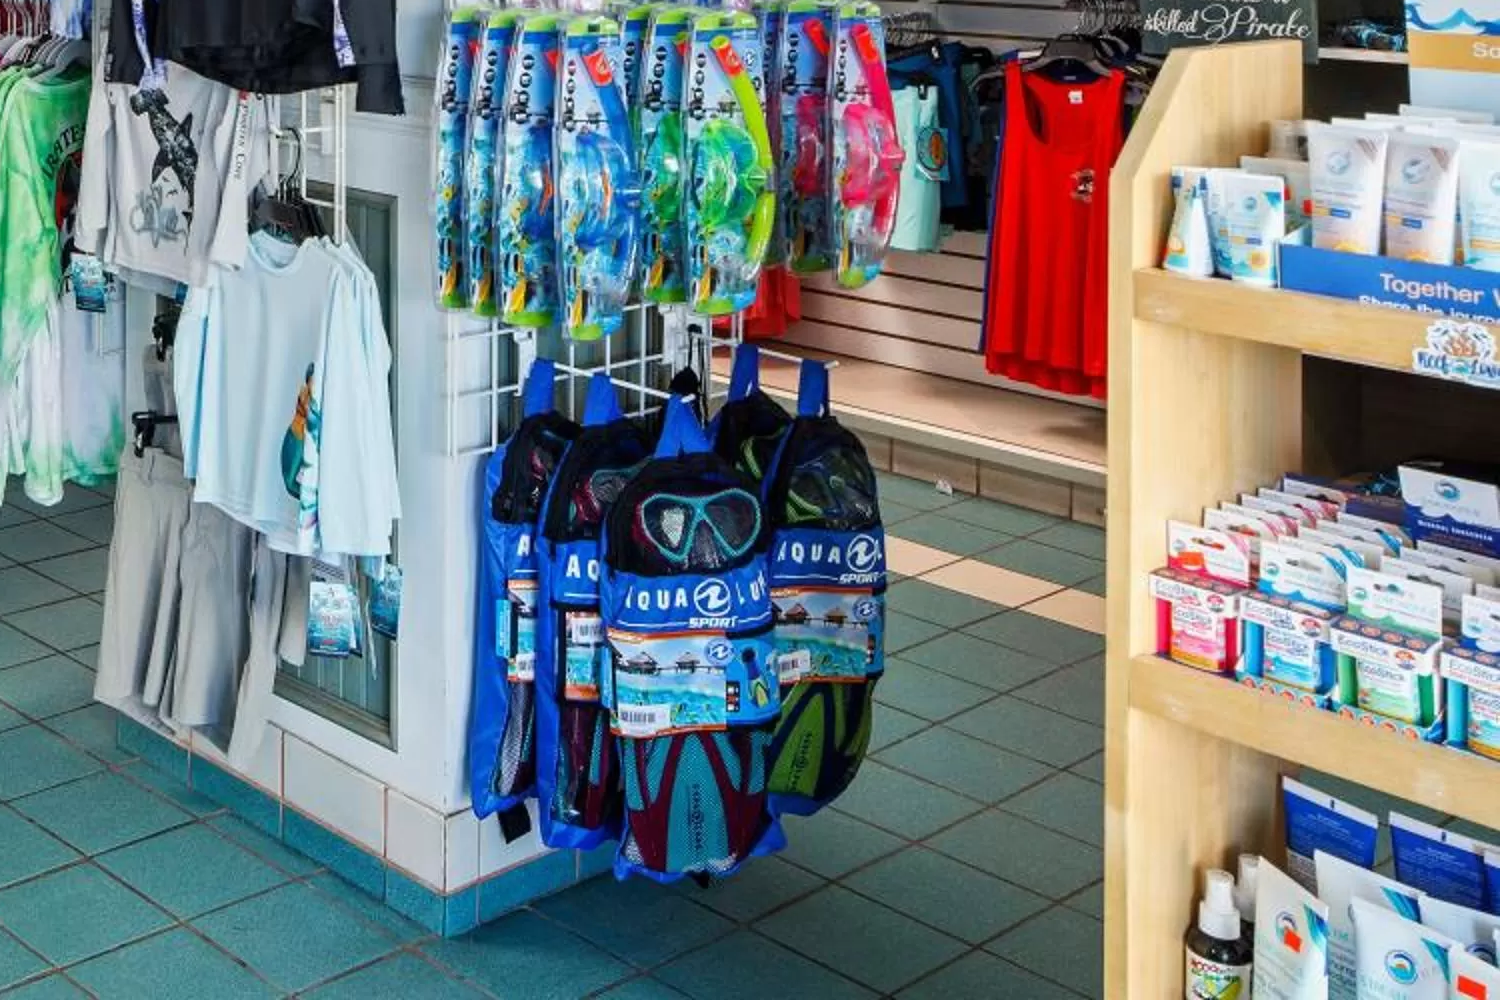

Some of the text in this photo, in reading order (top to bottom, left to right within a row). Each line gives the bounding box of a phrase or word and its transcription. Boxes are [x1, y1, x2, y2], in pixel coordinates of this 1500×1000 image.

[1143, 3, 1313, 45] skilled Pirate
[1380, 272, 1485, 304] Together
[687, 615, 738, 629] SPORT
